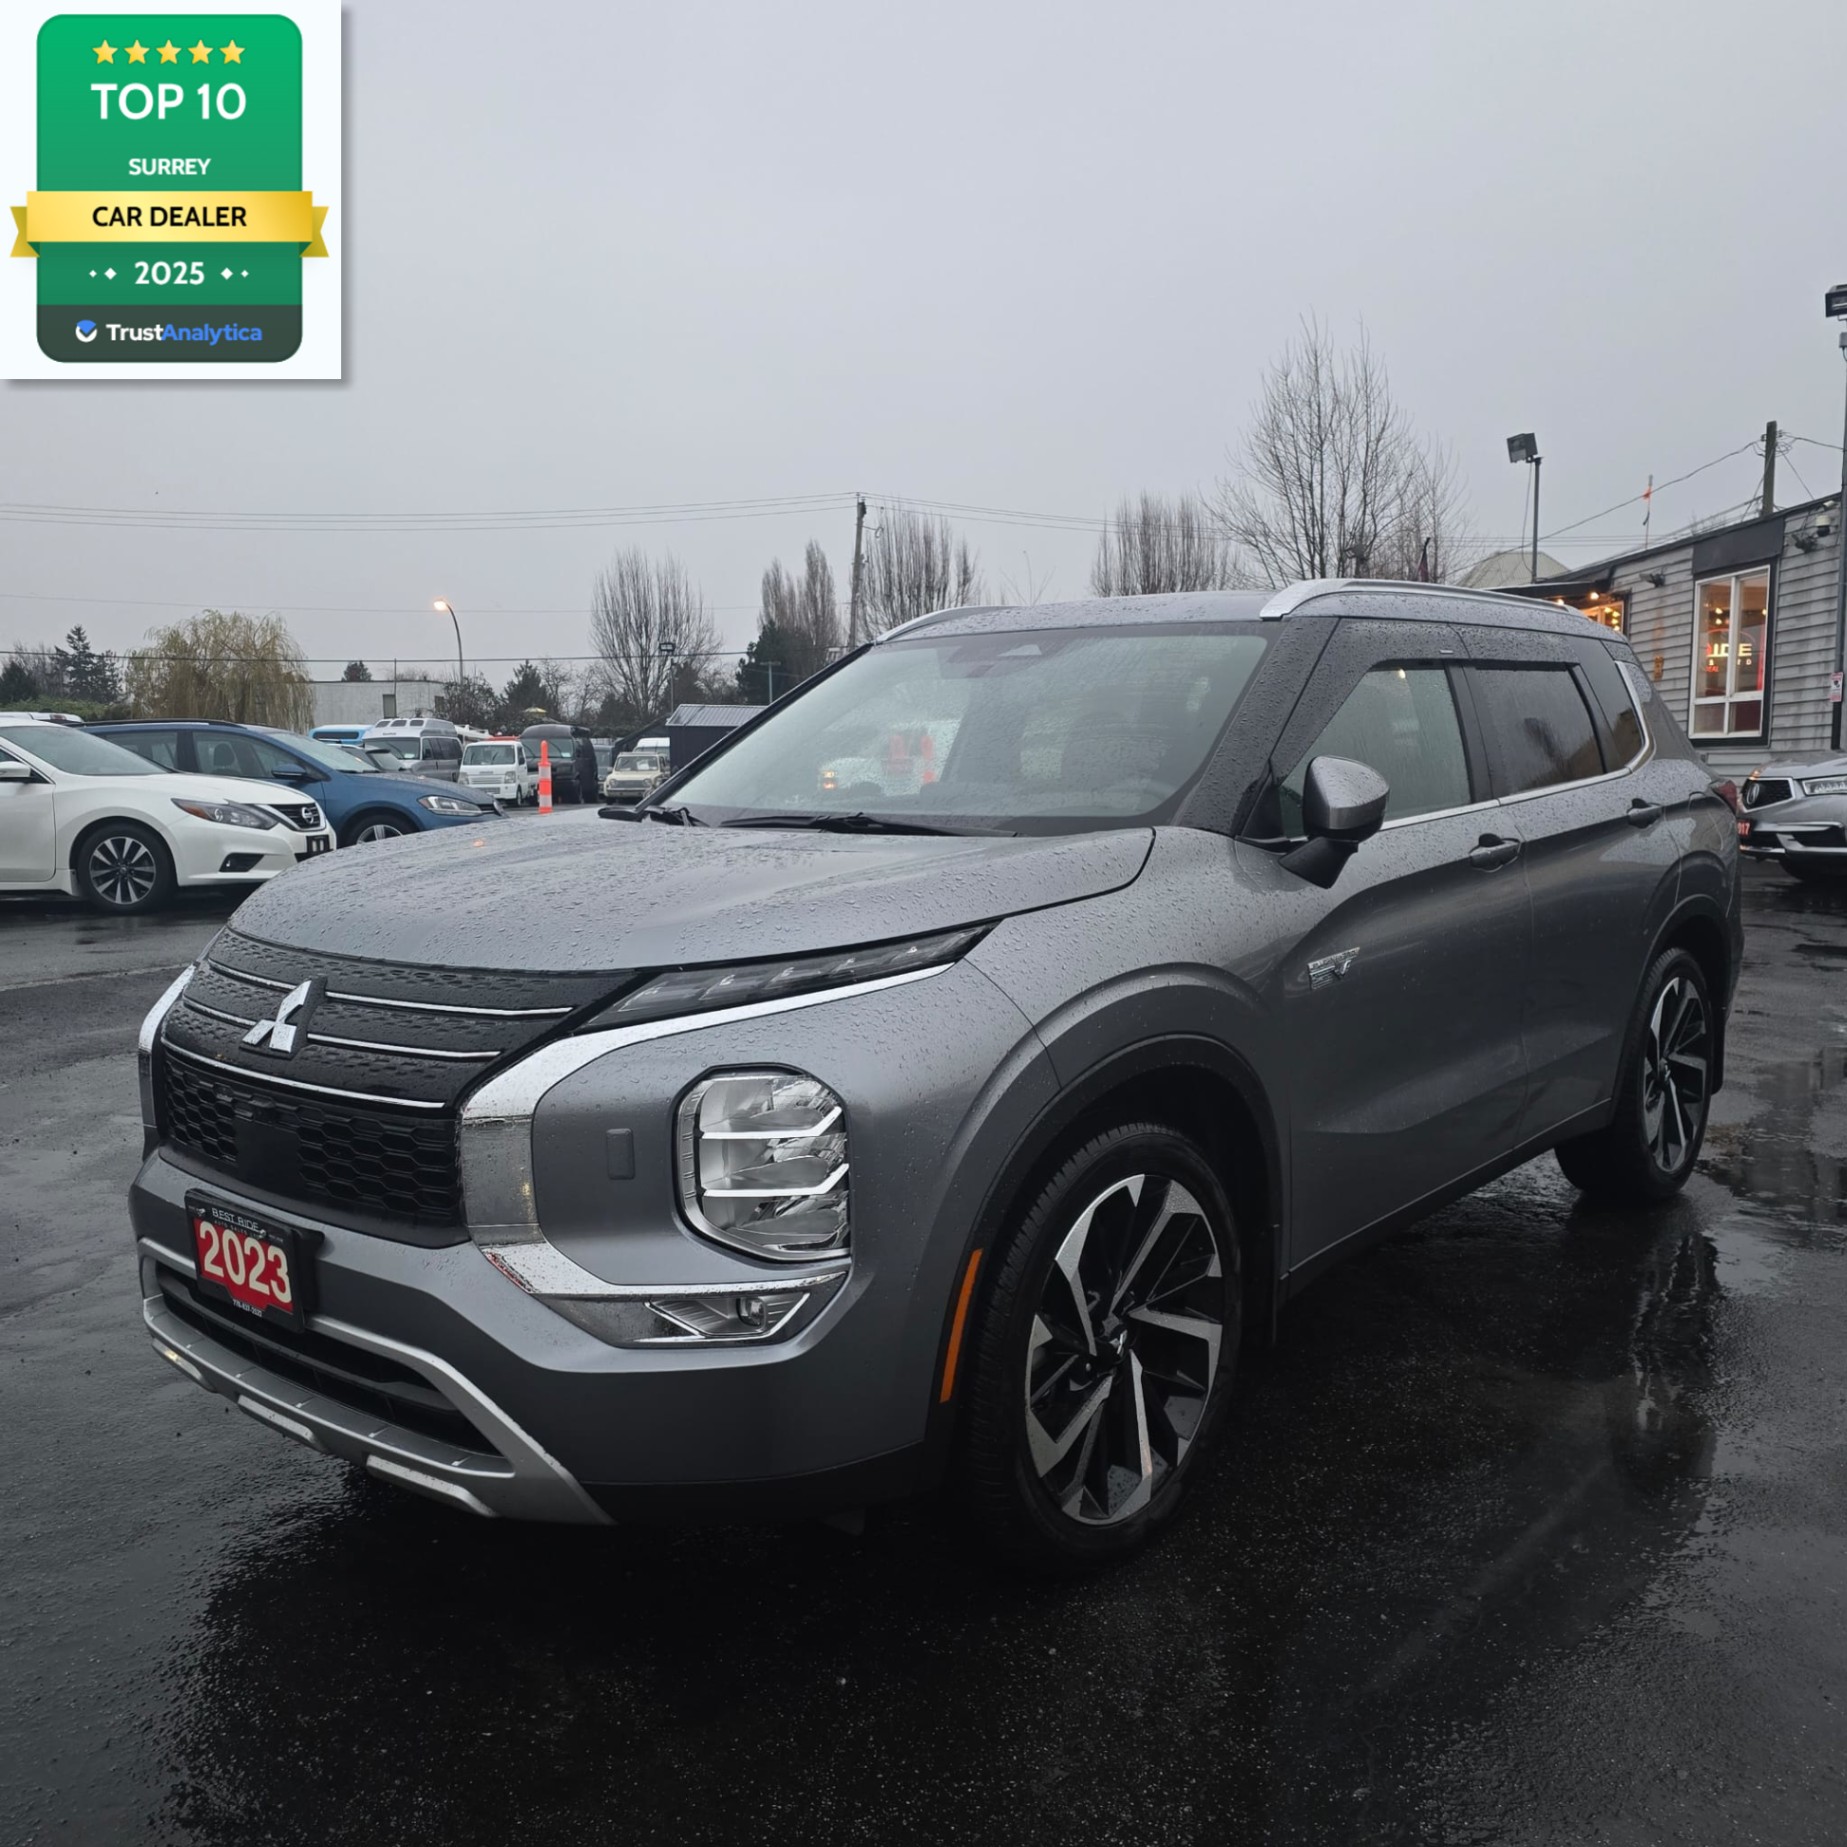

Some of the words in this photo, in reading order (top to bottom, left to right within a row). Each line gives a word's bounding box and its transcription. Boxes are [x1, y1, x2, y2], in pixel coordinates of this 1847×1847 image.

[211, 1207, 235, 1224] BEST
[237, 1216, 259, 1231] RIDE
[199, 1221, 292, 1304] 2023
